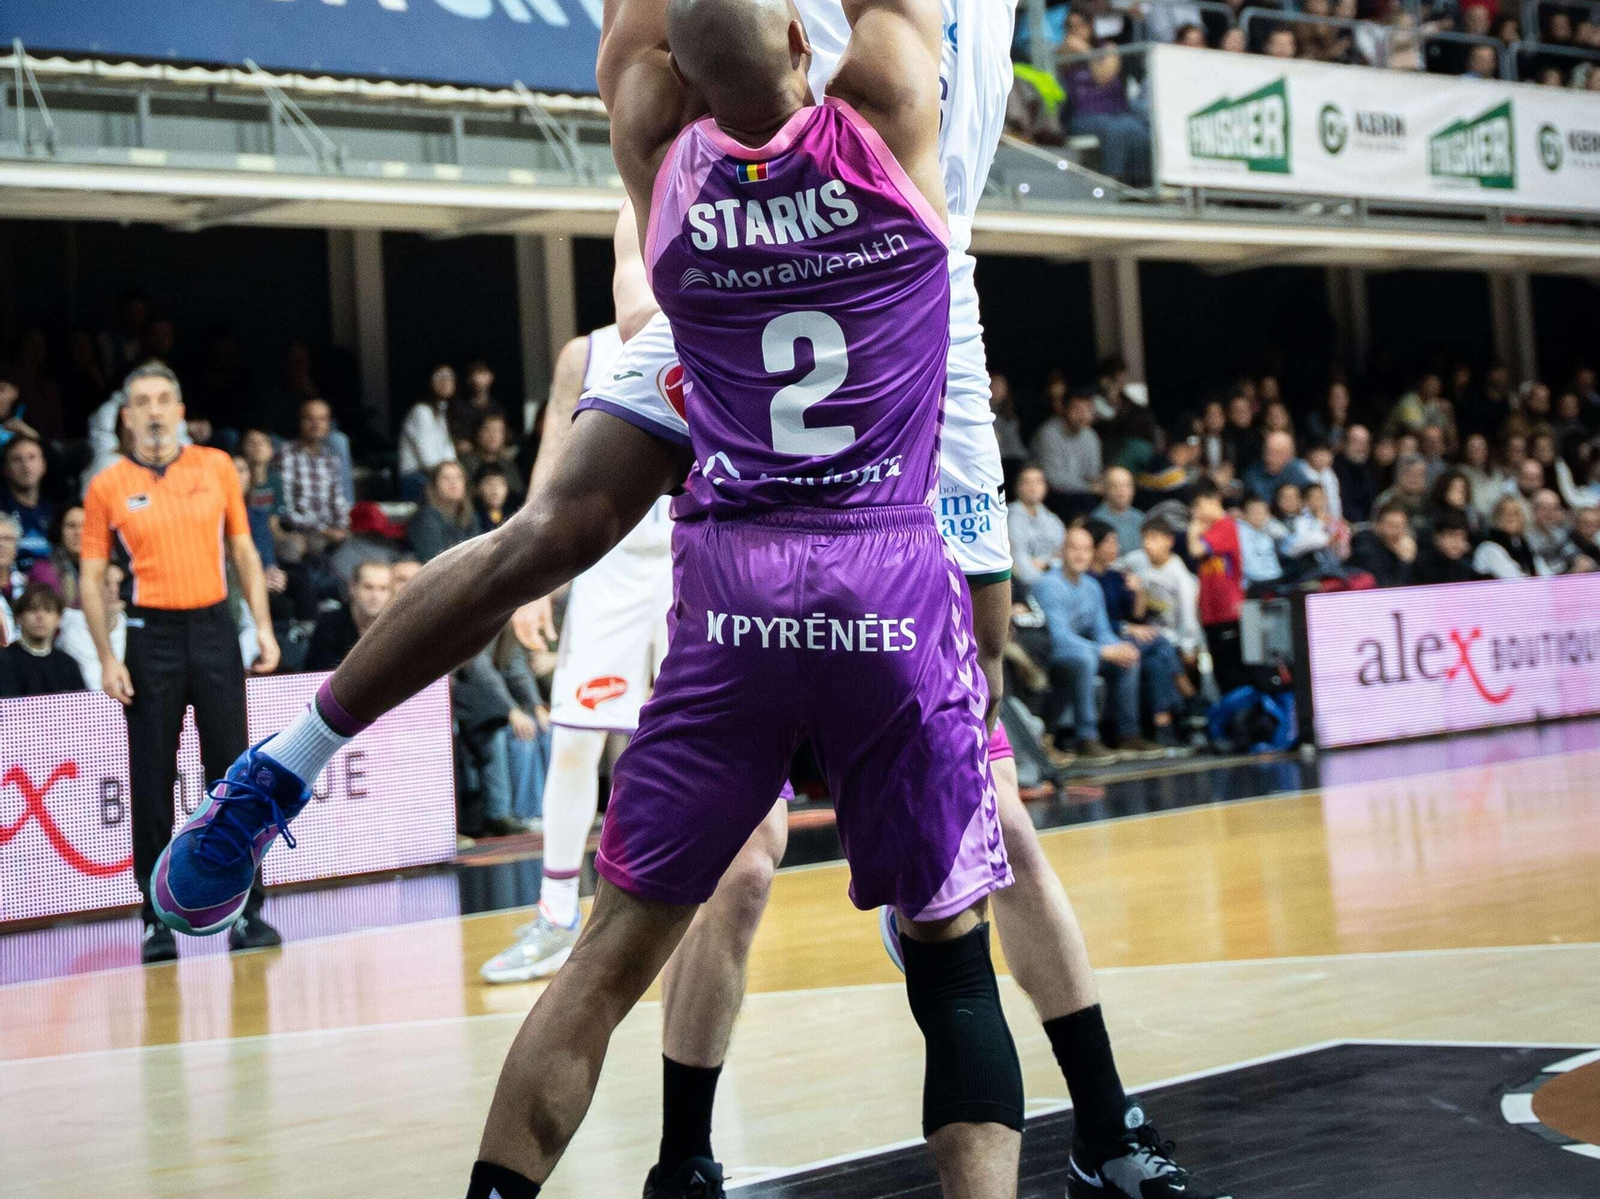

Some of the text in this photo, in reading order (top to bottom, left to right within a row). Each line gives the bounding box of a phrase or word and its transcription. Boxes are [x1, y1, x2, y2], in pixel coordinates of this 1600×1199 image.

[688, 179, 859, 251] STARKS
[711, 231, 909, 289] MoraWealth
[761, 310, 856, 456] 2
[1357, 611, 1515, 704] alex
